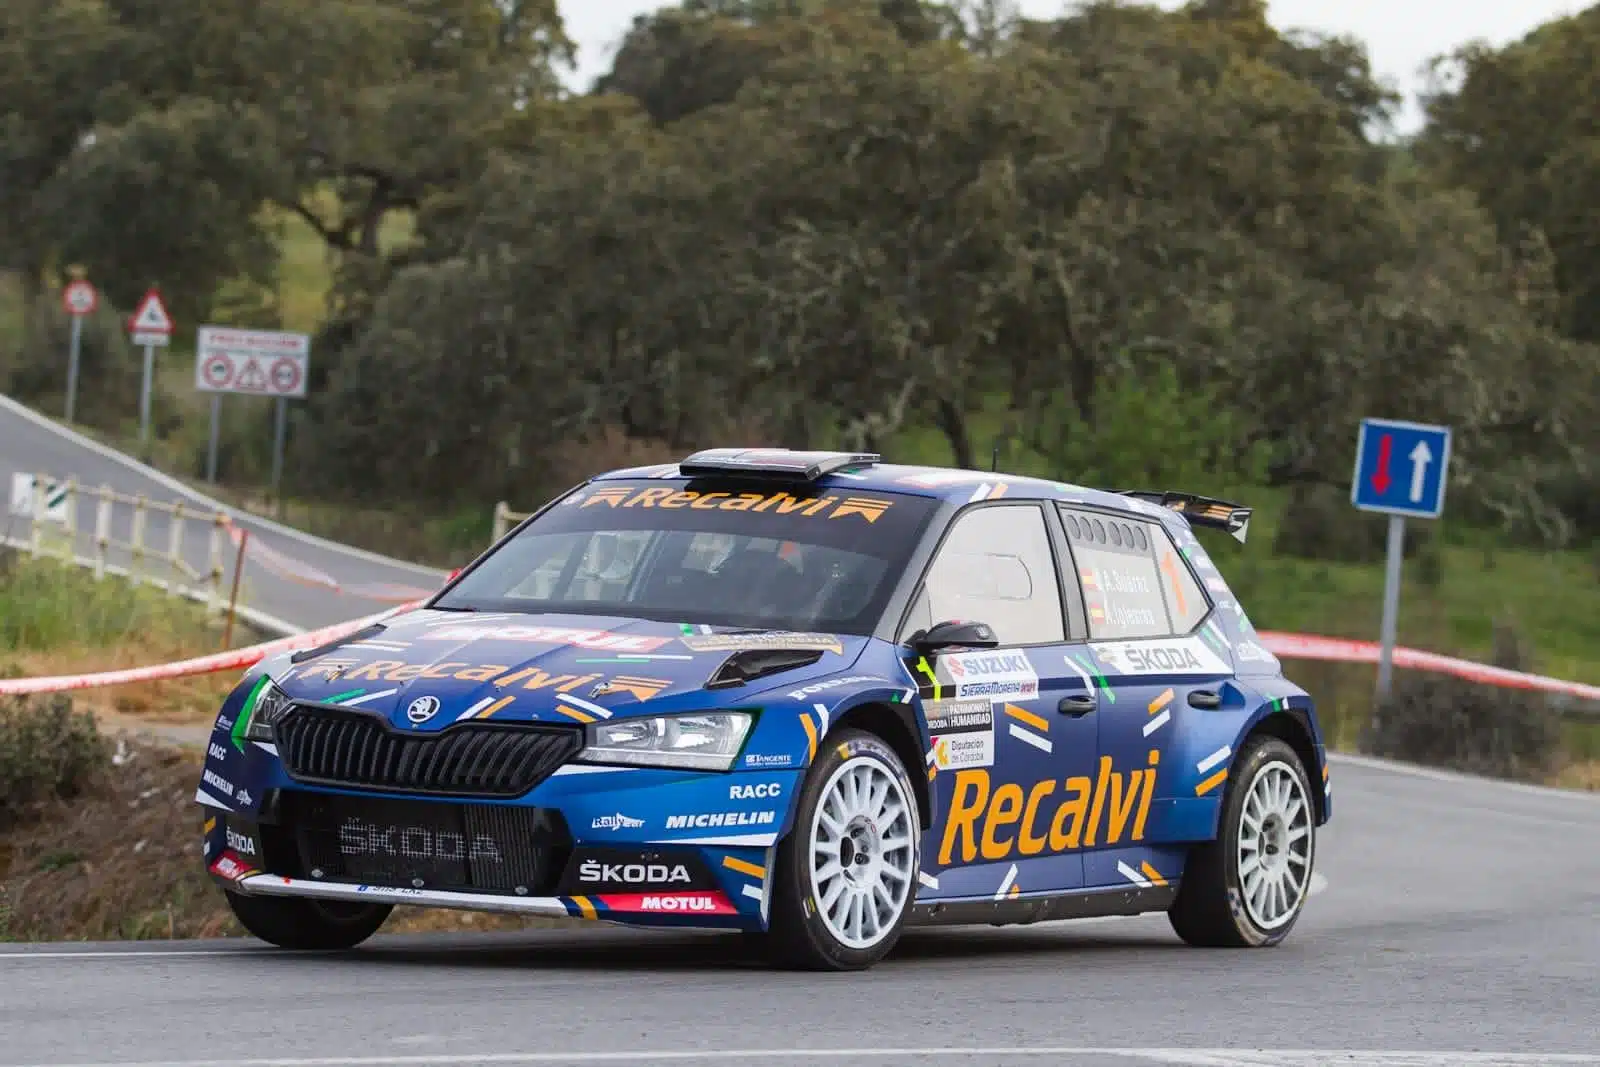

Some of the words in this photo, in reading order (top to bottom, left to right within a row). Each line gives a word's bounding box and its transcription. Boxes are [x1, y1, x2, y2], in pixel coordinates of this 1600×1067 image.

[624, 487, 841, 516] Recalvi
[1160, 551, 1188, 617] 1
[963, 655, 1029, 676] SUZUKI
[1124, 644, 1204, 671] ŠKODA
[343, 658, 604, 693] Recalvi
[916, 656, 942, 702] 1
[951, 714, 991, 727] HUMANIDAD
[208, 742, 228, 761] RACC
[203, 768, 235, 797] MICHELIN
[729, 783, 781, 800] RACC
[665, 811, 775, 829] MICHELIN
[937, 749, 1160, 865] Recalvi
[225, 826, 256, 856] ŠKODA
[338, 816, 503, 864] ŠKODA
[579, 859, 691, 883] ŠKODA
[641, 896, 716, 911] MOTUL
